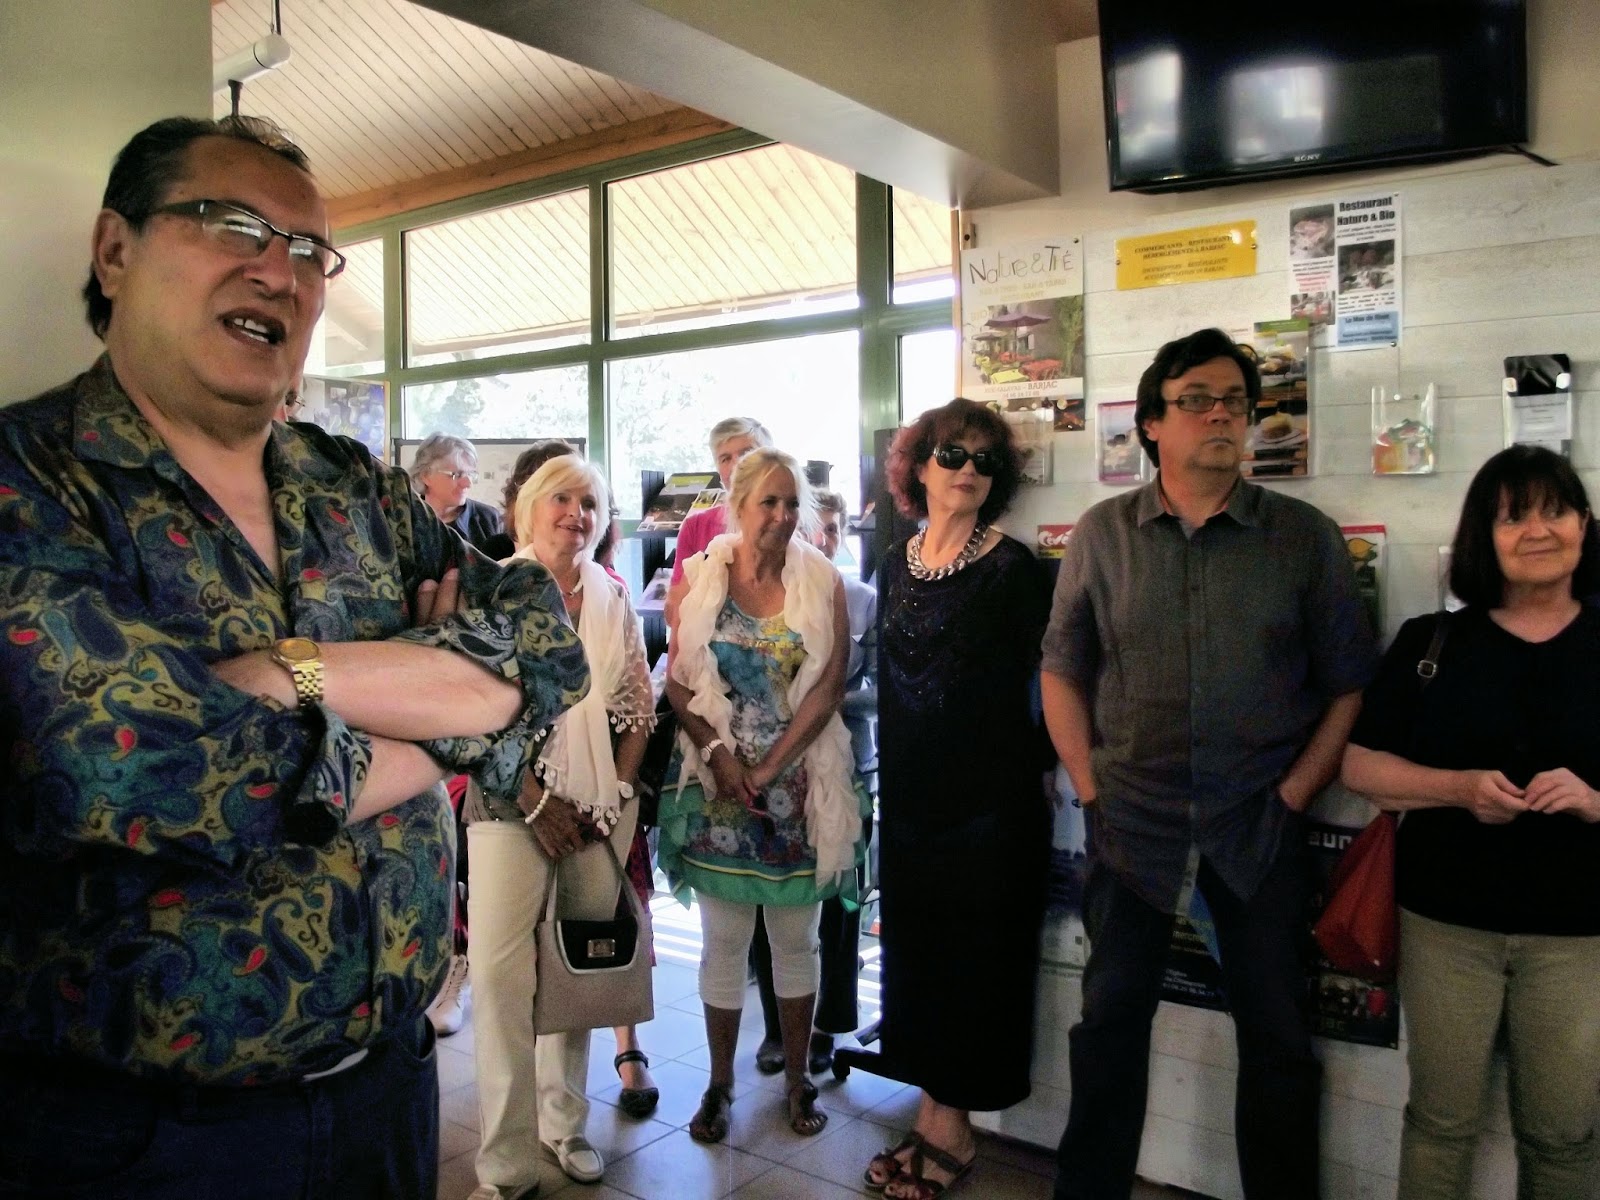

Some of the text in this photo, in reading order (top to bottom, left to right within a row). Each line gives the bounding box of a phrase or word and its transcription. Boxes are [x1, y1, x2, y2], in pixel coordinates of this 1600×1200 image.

[1294, 154, 1320, 162] SONY
[1339, 197, 1392, 212] Restaurant
[1337, 210, 1395, 226] Nature & Bio
[969, 249, 1028, 284] Nature
[1028, 381, 1058, 391] BARJAC
